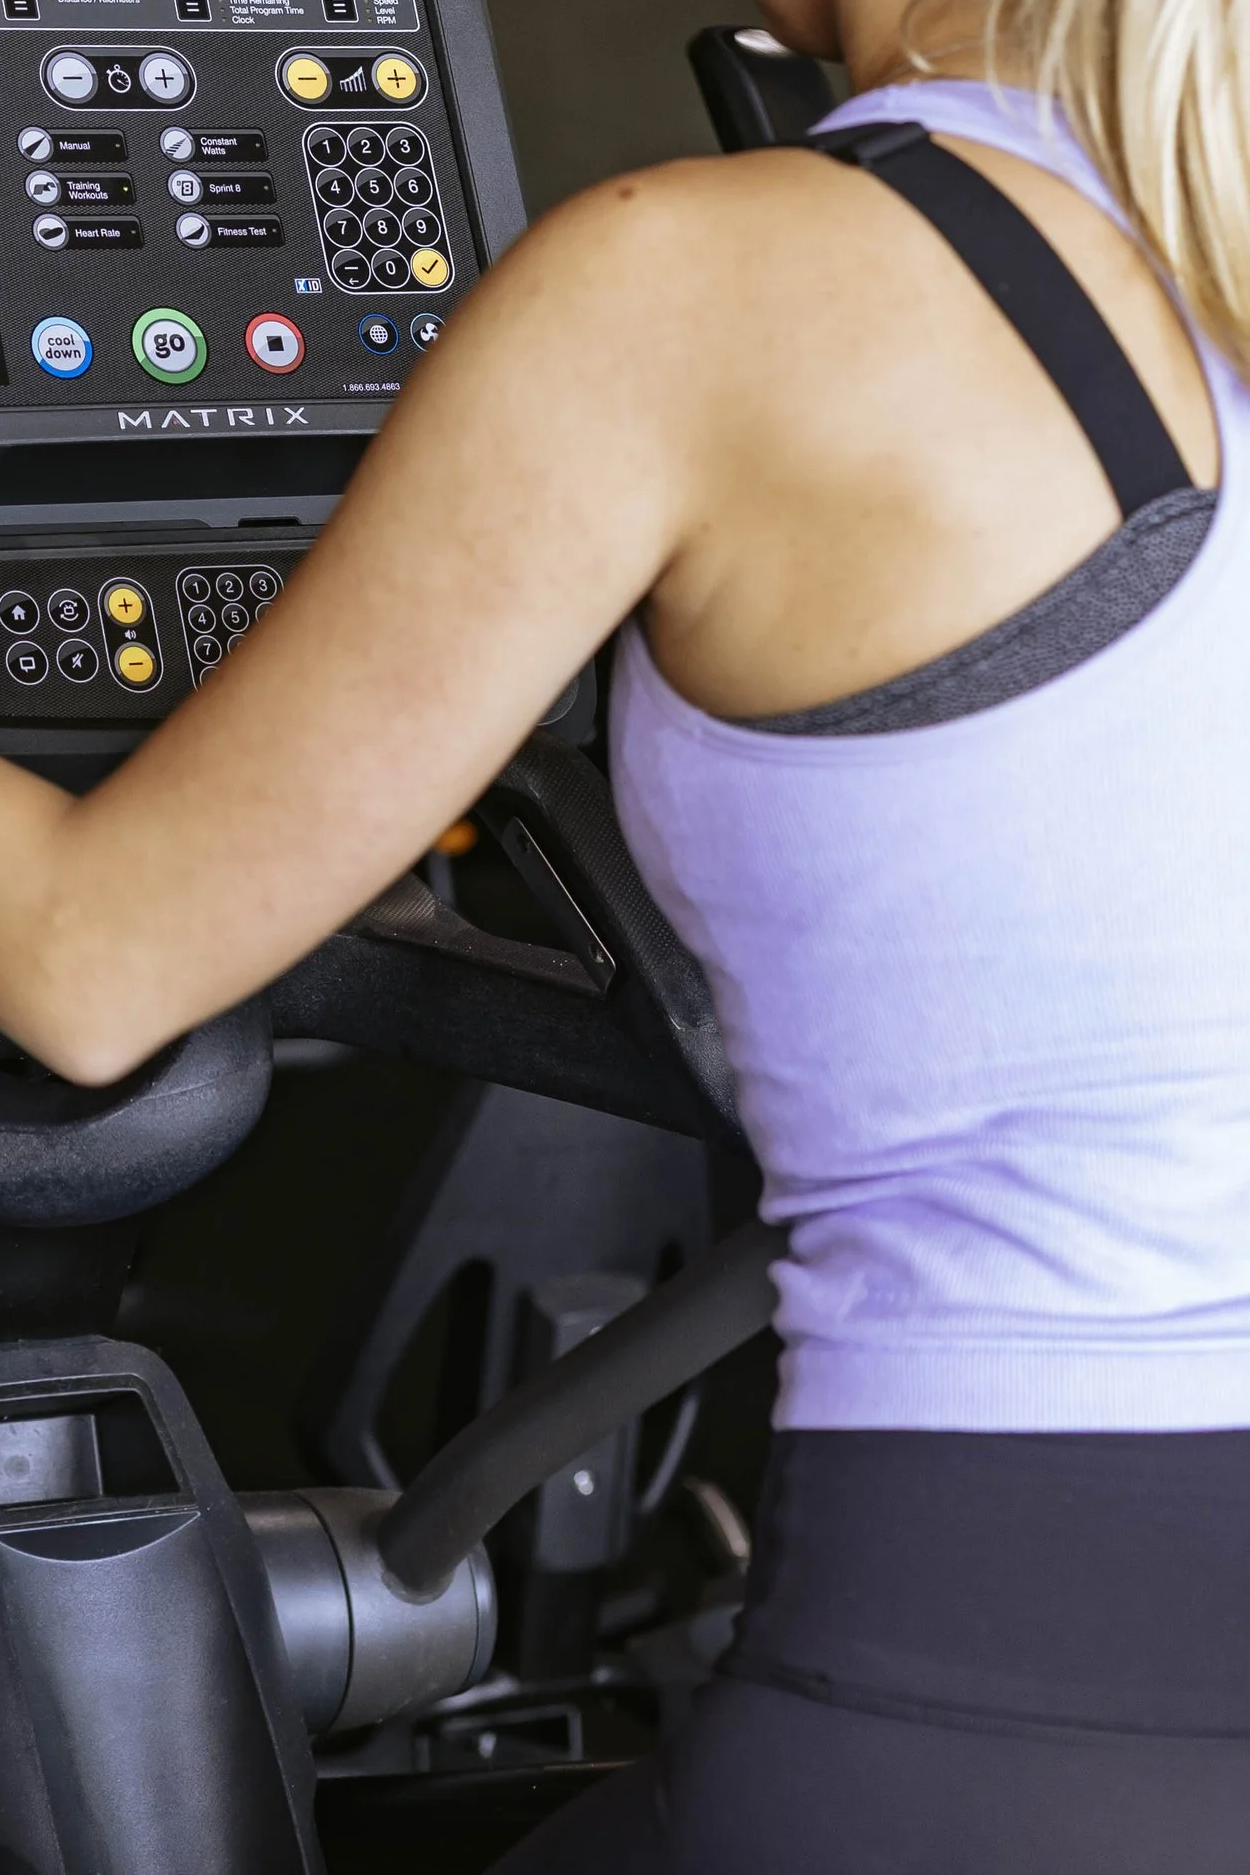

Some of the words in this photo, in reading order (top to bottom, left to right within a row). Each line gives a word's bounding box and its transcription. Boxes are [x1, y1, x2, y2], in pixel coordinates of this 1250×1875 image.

[229, 6, 249, 15] Total
[250, 6, 281, 17] Program
[282, 7, 304, 15] Time
[375, 7, 395, 15] Level
[232, 16, 255, 25] Clock
[377, 16, 396, 25] RPM
[60, 141, 91, 150] Manual
[201, 138, 237, 146] Constant
[323, 140, 330, 154] 1
[361, 140, 371, 153] 2
[400, 139, 410, 153] 3
[202, 147, 226, 155] Watts
[67, 182, 100, 192] Training
[210, 184, 233, 194] Sprint
[235, 184, 241, 192] 8
[331, 180, 340, 194] 4
[370, 180, 380, 194] 5
[408, 179, 419, 193] 6
[69, 191, 108, 200] Workouts
[218, 227, 248, 236] Fitness
[249, 227, 266, 236] Test
[338, 221, 347, 235] 7
[378, 220, 388, 234] 8
[416, 220, 427, 233] 9
[75, 229, 99, 237] Heart
[100, 229, 120, 237] Rate
[385, 261, 396, 275] 0
[47, 335, 75, 348] cool
[153, 331, 185, 359] go
[45, 345, 82, 360] down
[342, 382, 401, 393] 1.866.693.4863
[117, 406, 309, 430] MATRIX
[192, 582, 200, 594] 1
[225, 581, 234, 593] 2
[259, 579, 268, 592] 3
[198, 613, 207, 625] 4
[231, 611, 240, 623] 5
[203, 643, 212, 655] 7
